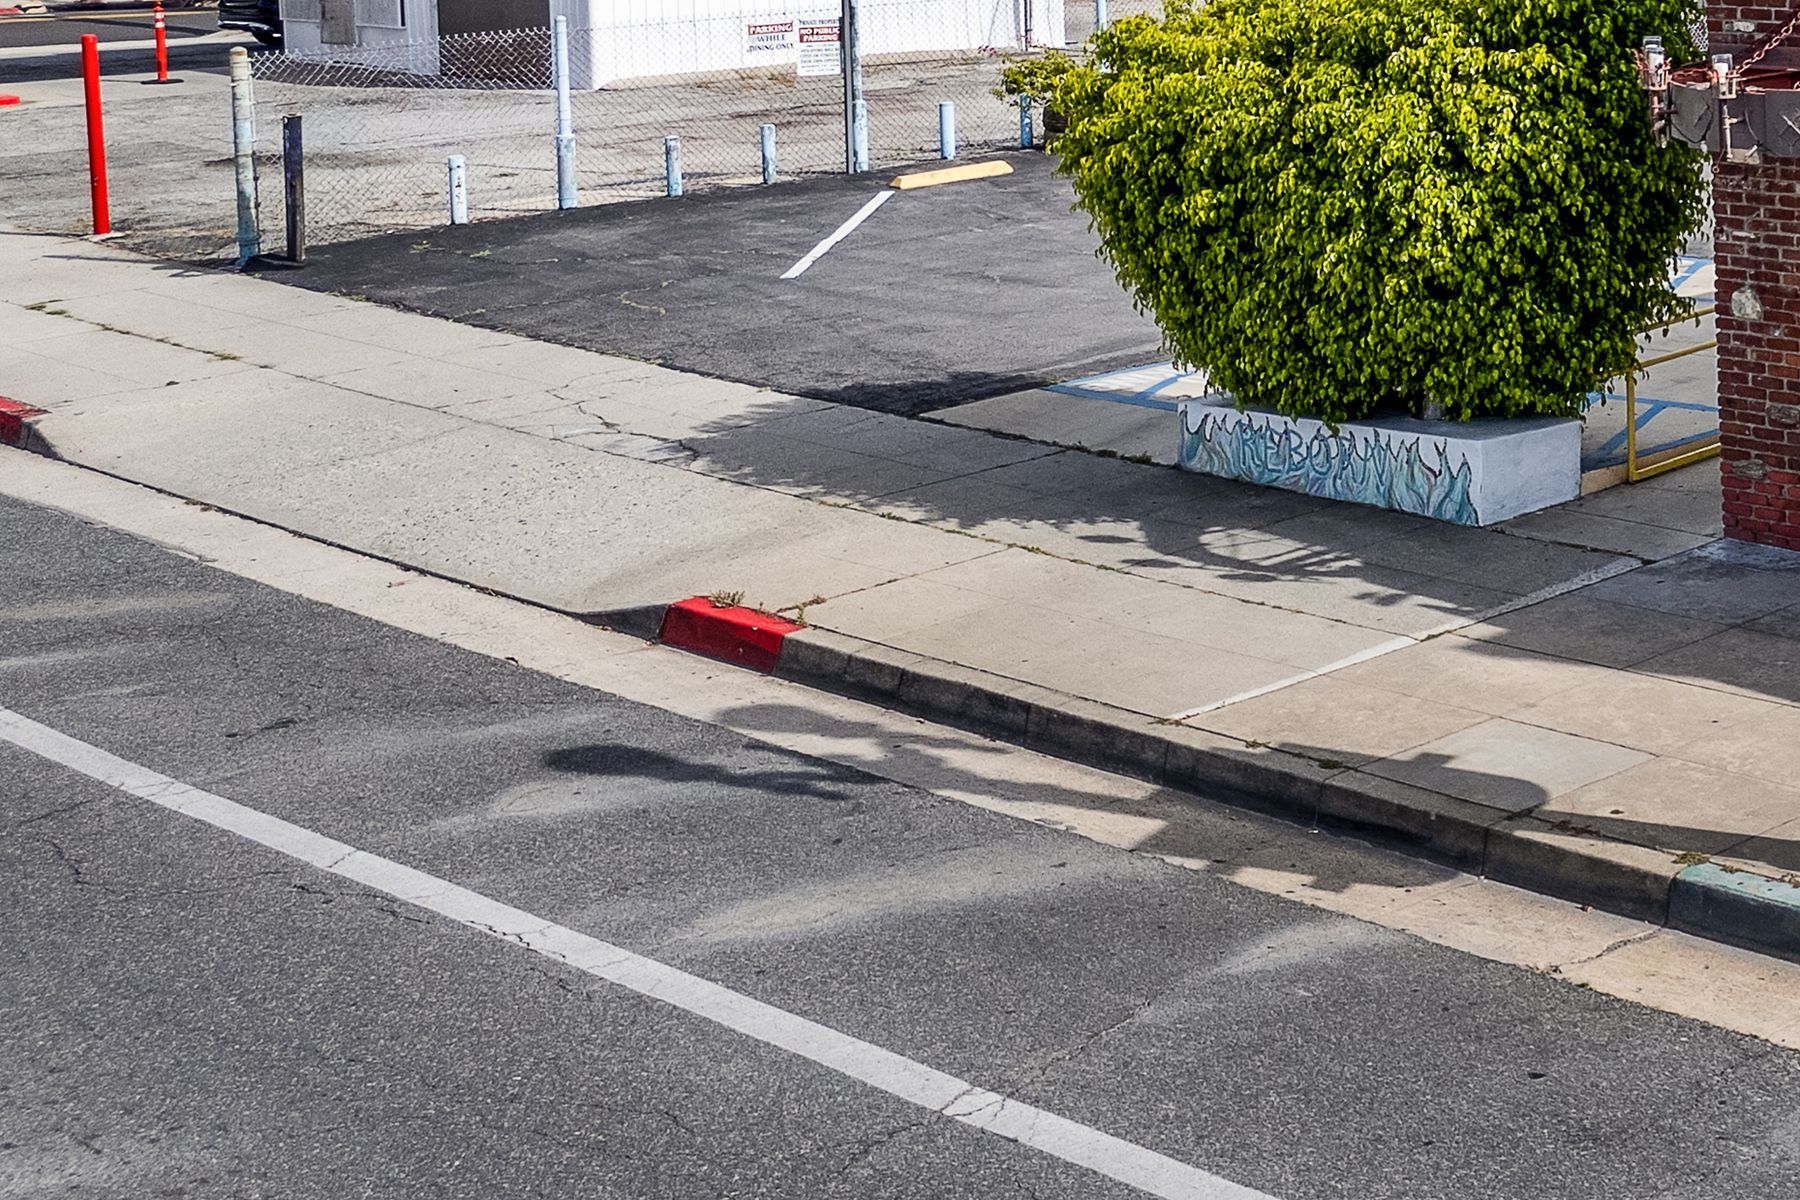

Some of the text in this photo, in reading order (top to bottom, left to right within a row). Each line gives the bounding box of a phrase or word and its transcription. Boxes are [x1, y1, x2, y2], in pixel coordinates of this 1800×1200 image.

[750, 23, 792, 34] PARKING
[757, 34, 785, 42] WHILE
[749, 44, 774, 52] DINING
